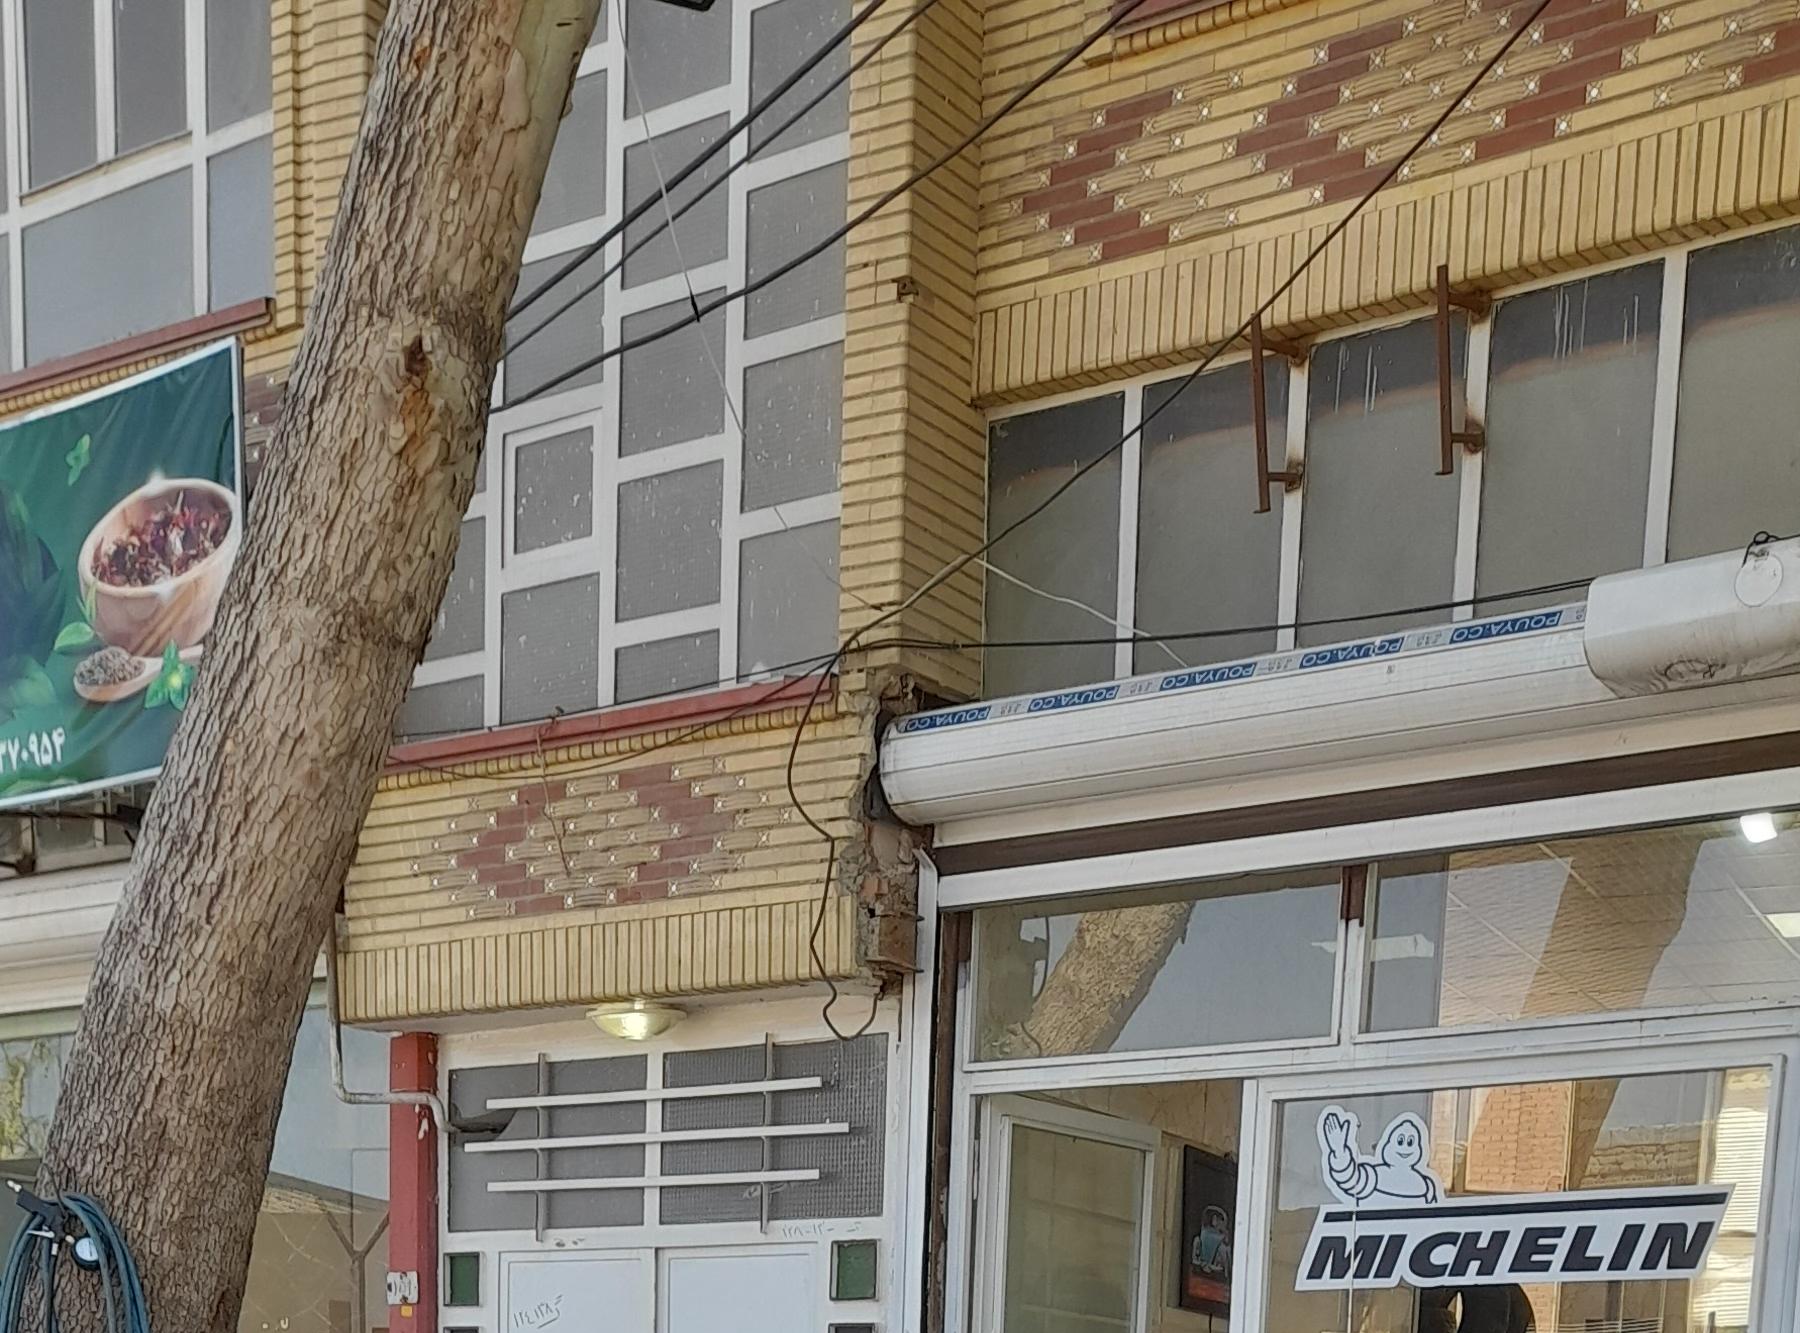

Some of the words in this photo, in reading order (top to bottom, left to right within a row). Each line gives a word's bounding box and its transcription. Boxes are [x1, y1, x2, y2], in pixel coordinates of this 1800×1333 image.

[1453, 610, 1561, 641] POUYA.CO
[1302, 638, 1403, 668] POUYA.CO
[1162, 662, 1257, 688] POUYA.CO
[1030, 685, 1119, 711] POUYA.CO
[907, 706, 989, 731] POUYA.CO
[1306, 1221, 1716, 1280] MICHELIN
